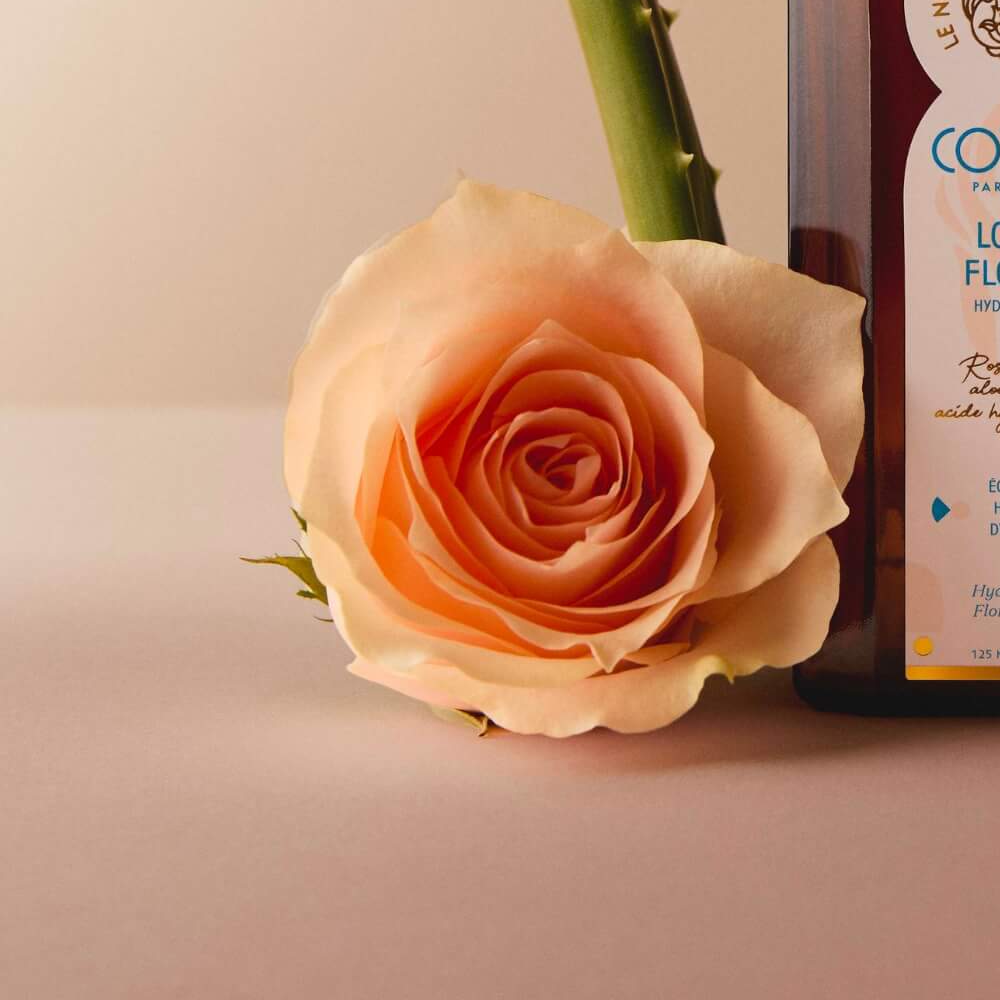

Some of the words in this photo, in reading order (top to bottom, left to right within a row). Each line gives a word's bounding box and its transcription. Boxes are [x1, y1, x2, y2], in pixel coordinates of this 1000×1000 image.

[936, 24, 959, 50] LE
[934, 403, 983, 418] acide
[971, 650, 992, 660] 125
